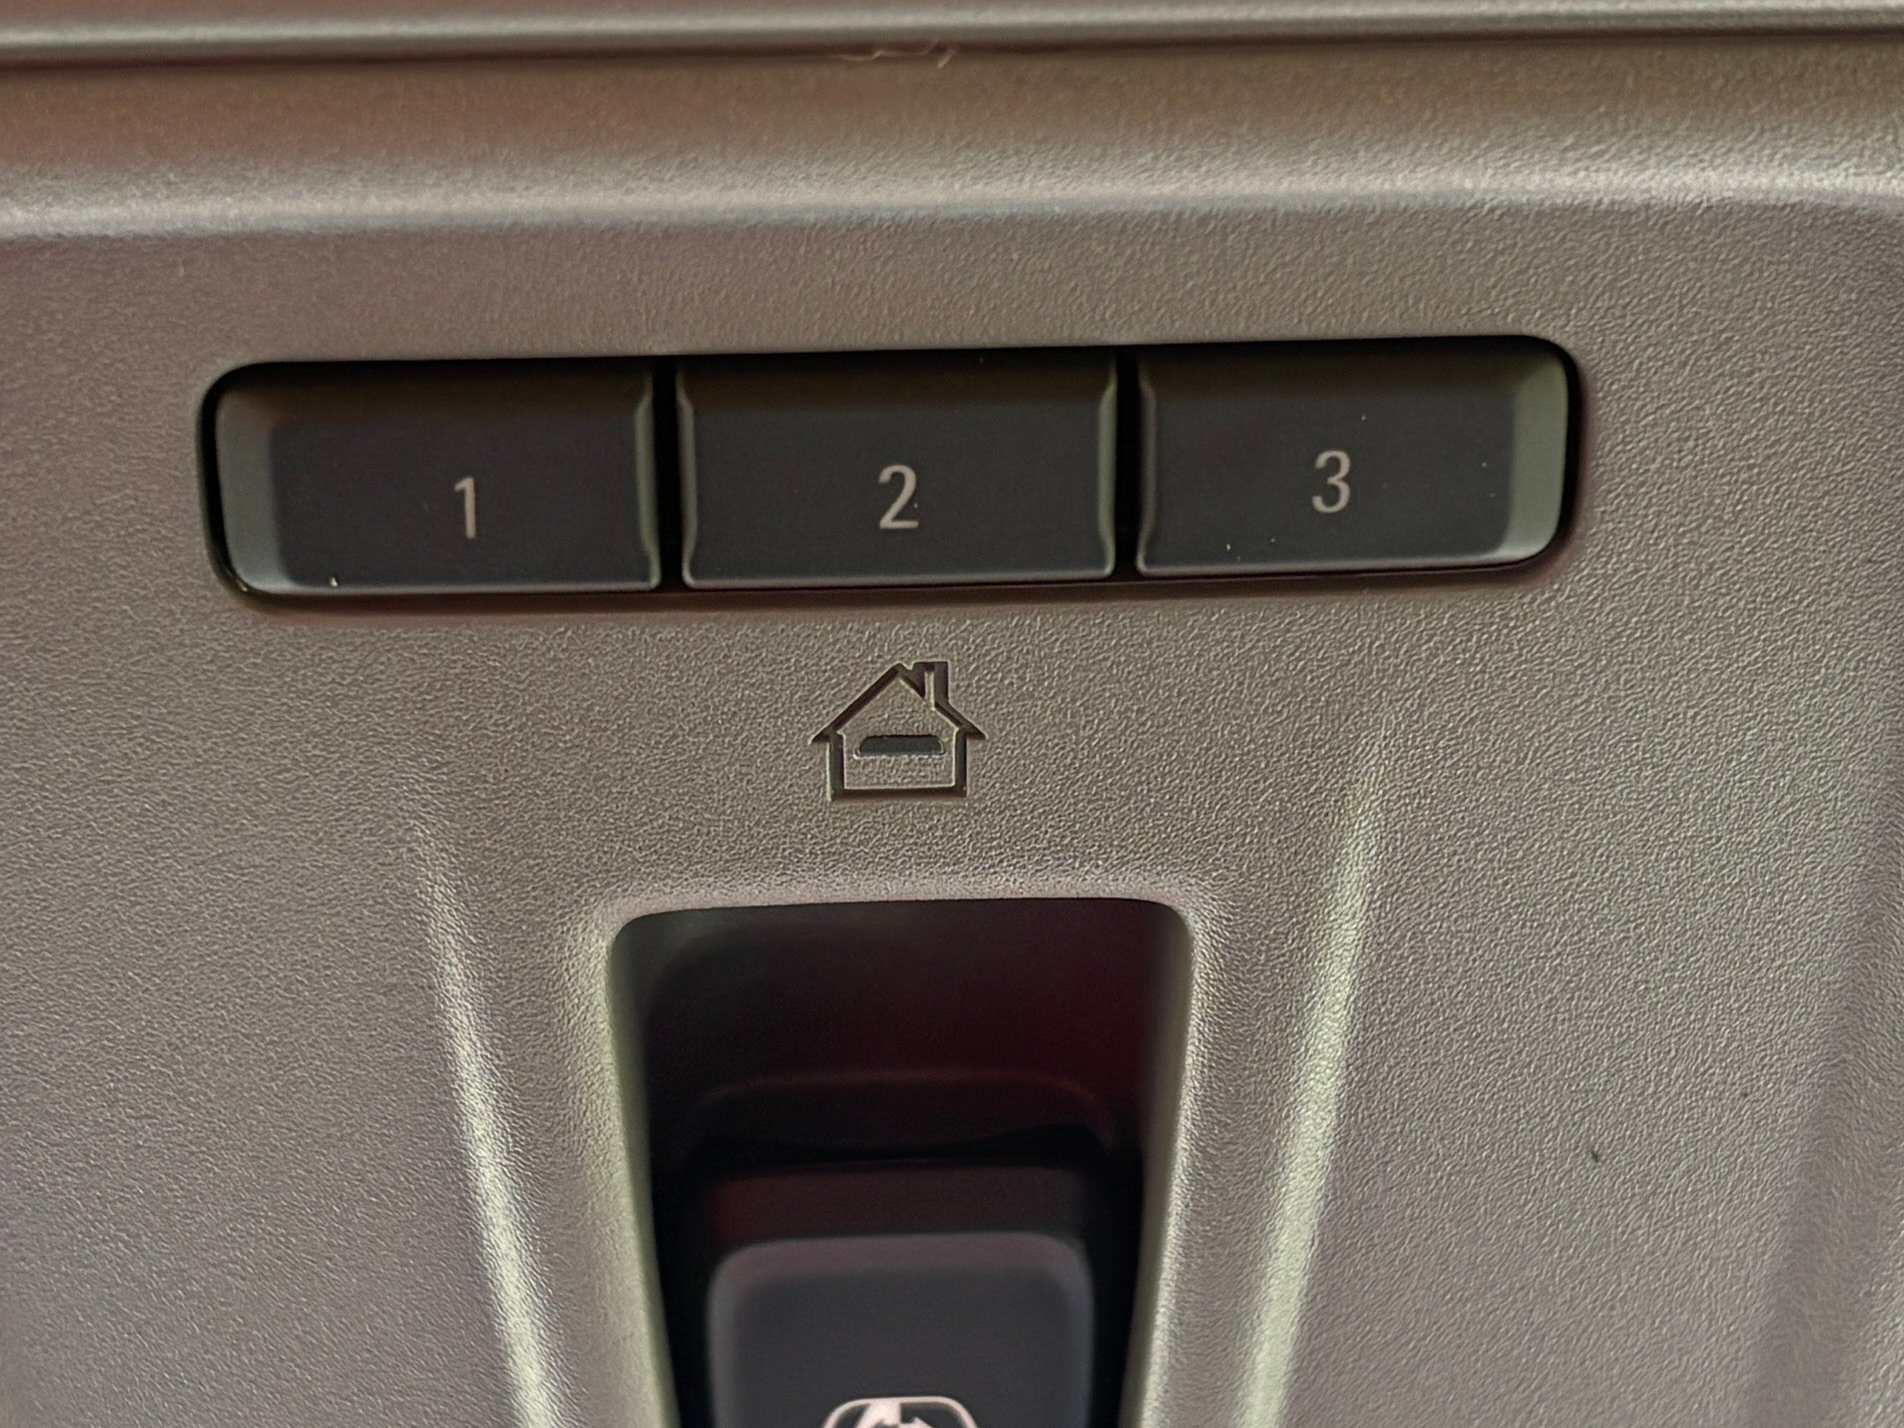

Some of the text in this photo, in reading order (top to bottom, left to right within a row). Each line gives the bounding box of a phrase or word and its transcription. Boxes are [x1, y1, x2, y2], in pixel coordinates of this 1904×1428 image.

[454, 476, 476, 540] 1
[878, 464, 919, 529] 2
[1312, 449, 1351, 513] 3
